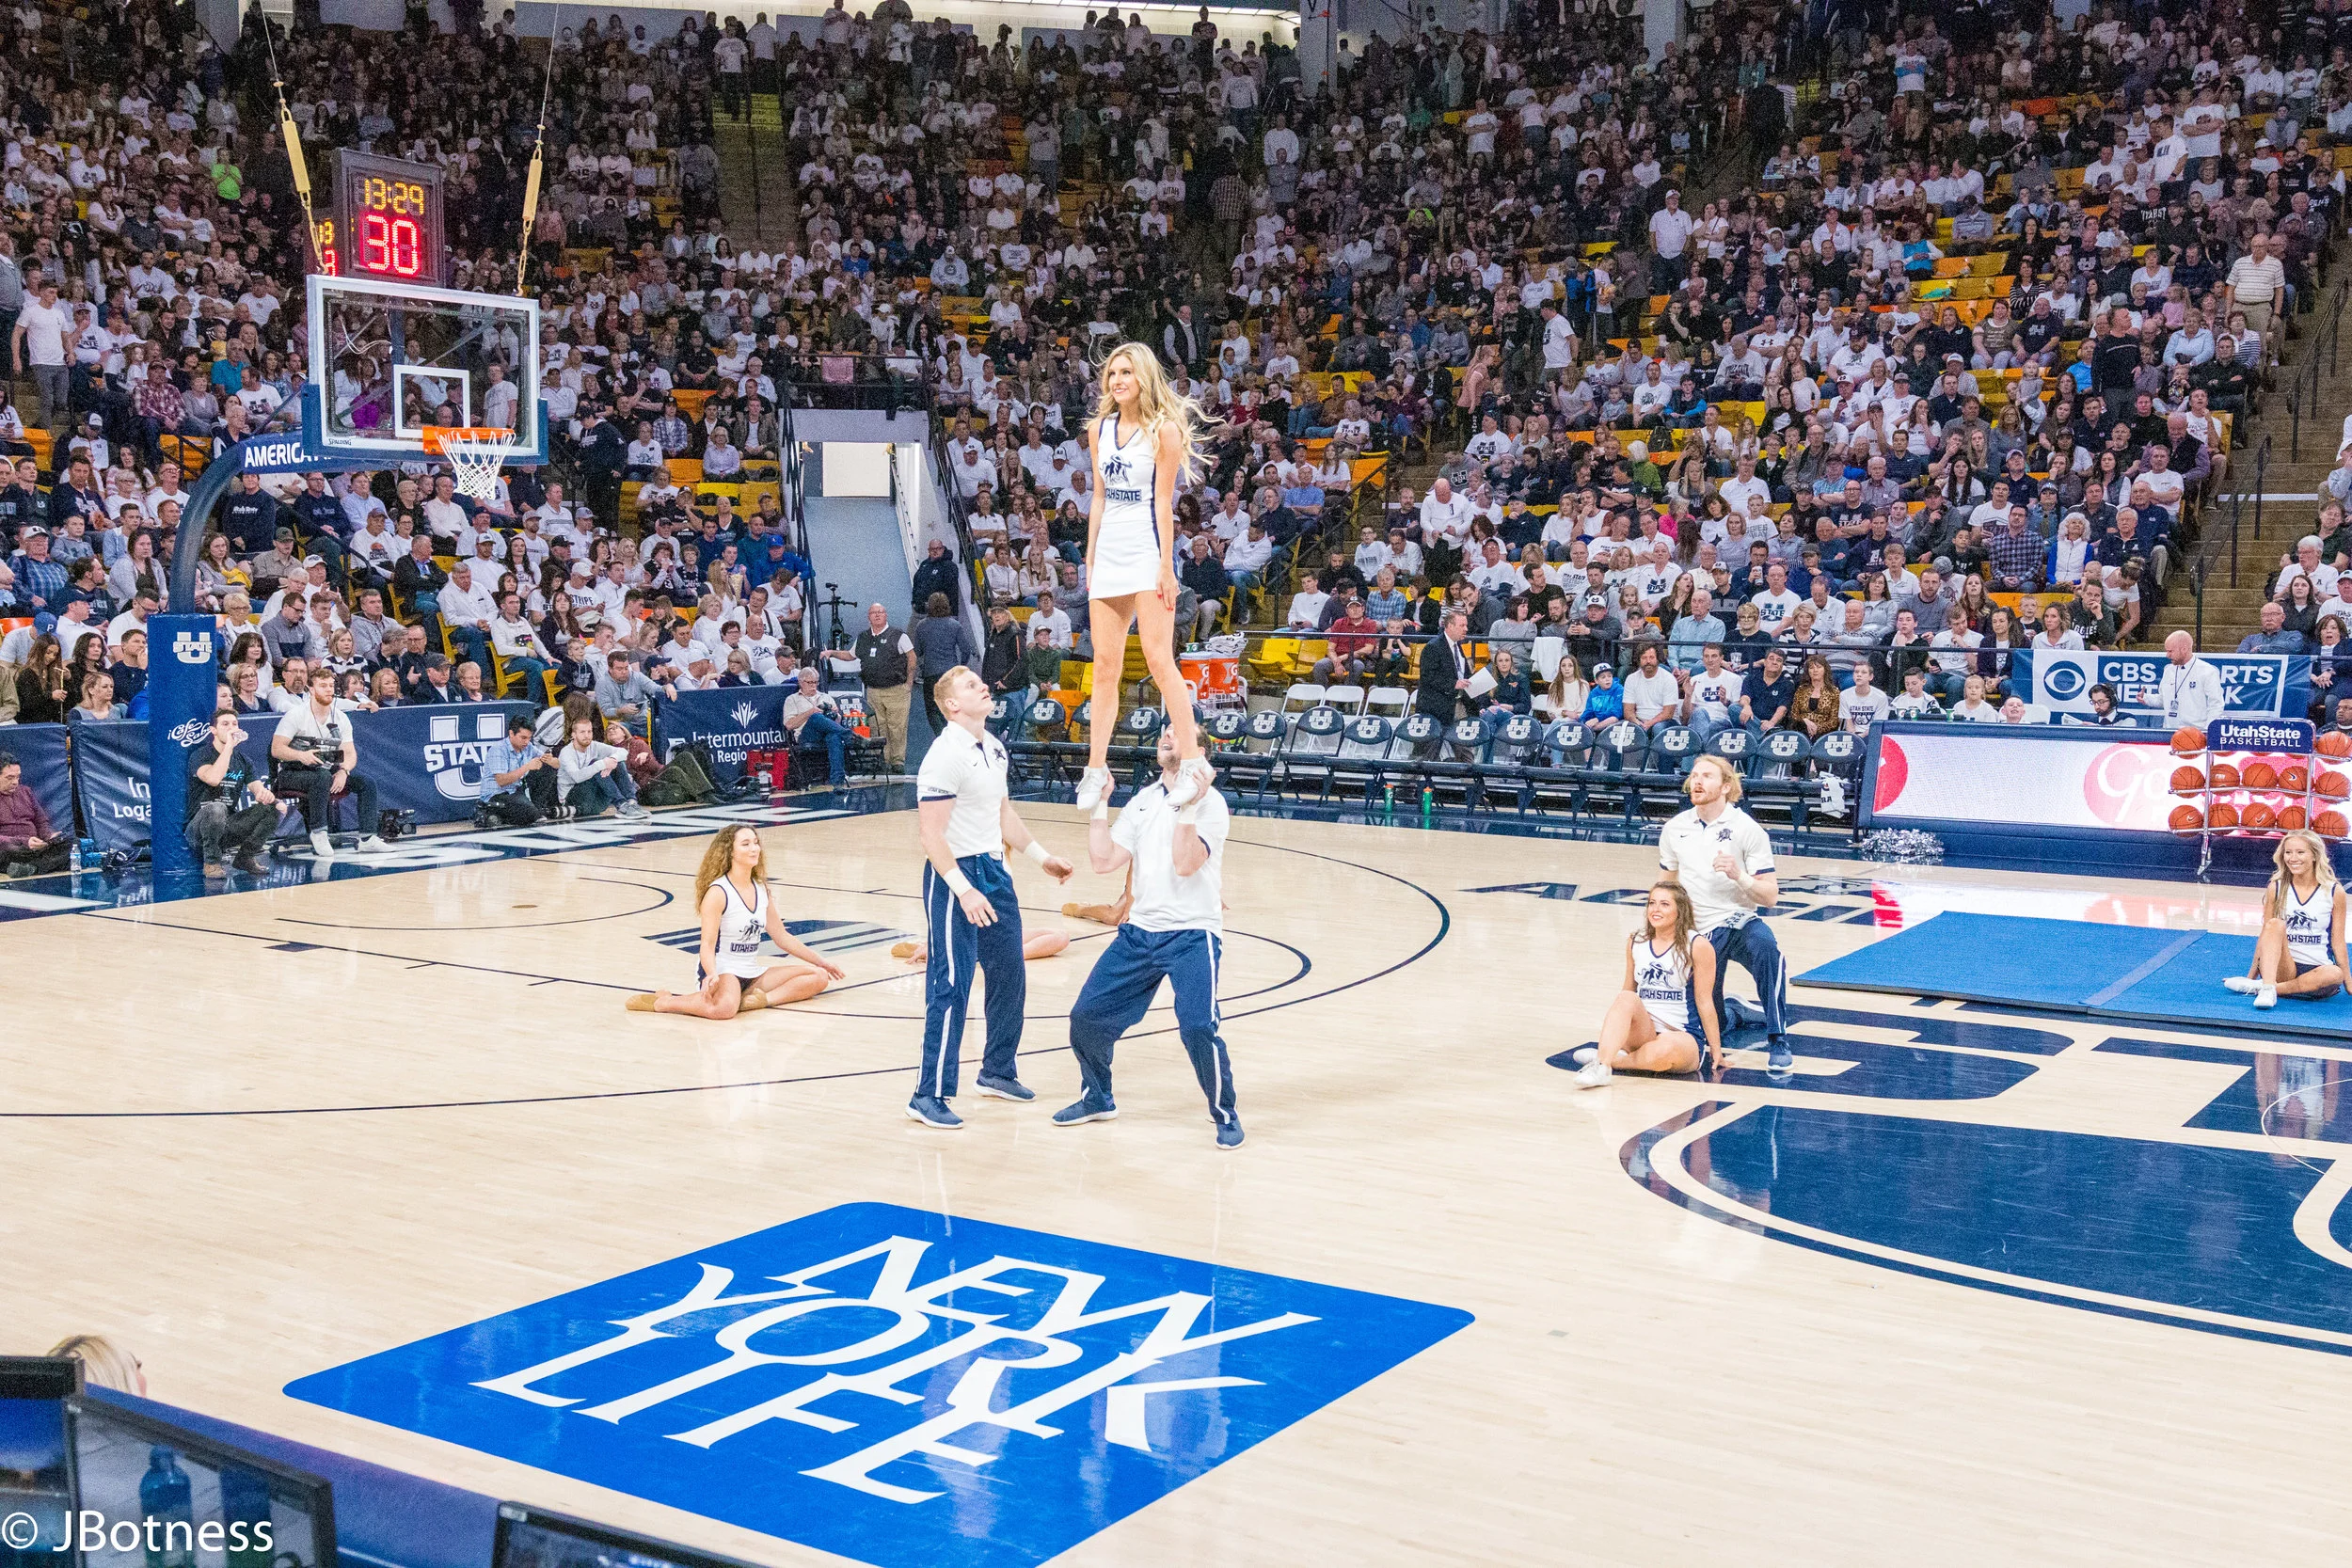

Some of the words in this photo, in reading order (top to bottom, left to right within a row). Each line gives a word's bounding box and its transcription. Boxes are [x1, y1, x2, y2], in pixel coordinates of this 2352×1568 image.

[364, 178, 424, 215] 13:29
[366, 214, 419, 275] 30
[1116, 489, 1140, 501] STATE
[173, 641, 213, 653] STATE
[2103, 661, 2156, 682] CBS
[2221, 664, 2274, 685] RTS
[692, 727, 786, 750] Itermounta
[2219, 724, 2300, 739] UtahState
[2219, 736, 2301, 748] BASKETBALL
[423, 742, 493, 772] STAT
[718, 748, 747, 765] Regio
[113, 803, 151, 821] Loga
[731, 942, 750, 953] UTAH
[2298, 935, 2321, 943] STATE
[1639, 989, 1656, 999] UTAH
[1656, 990, 1682, 1001] STATE
[764, 1235, 1322, 1360] NEW
[606, 1262, 1267, 1452] YORK
[468, 1331, 1064, 1504] LIFE
